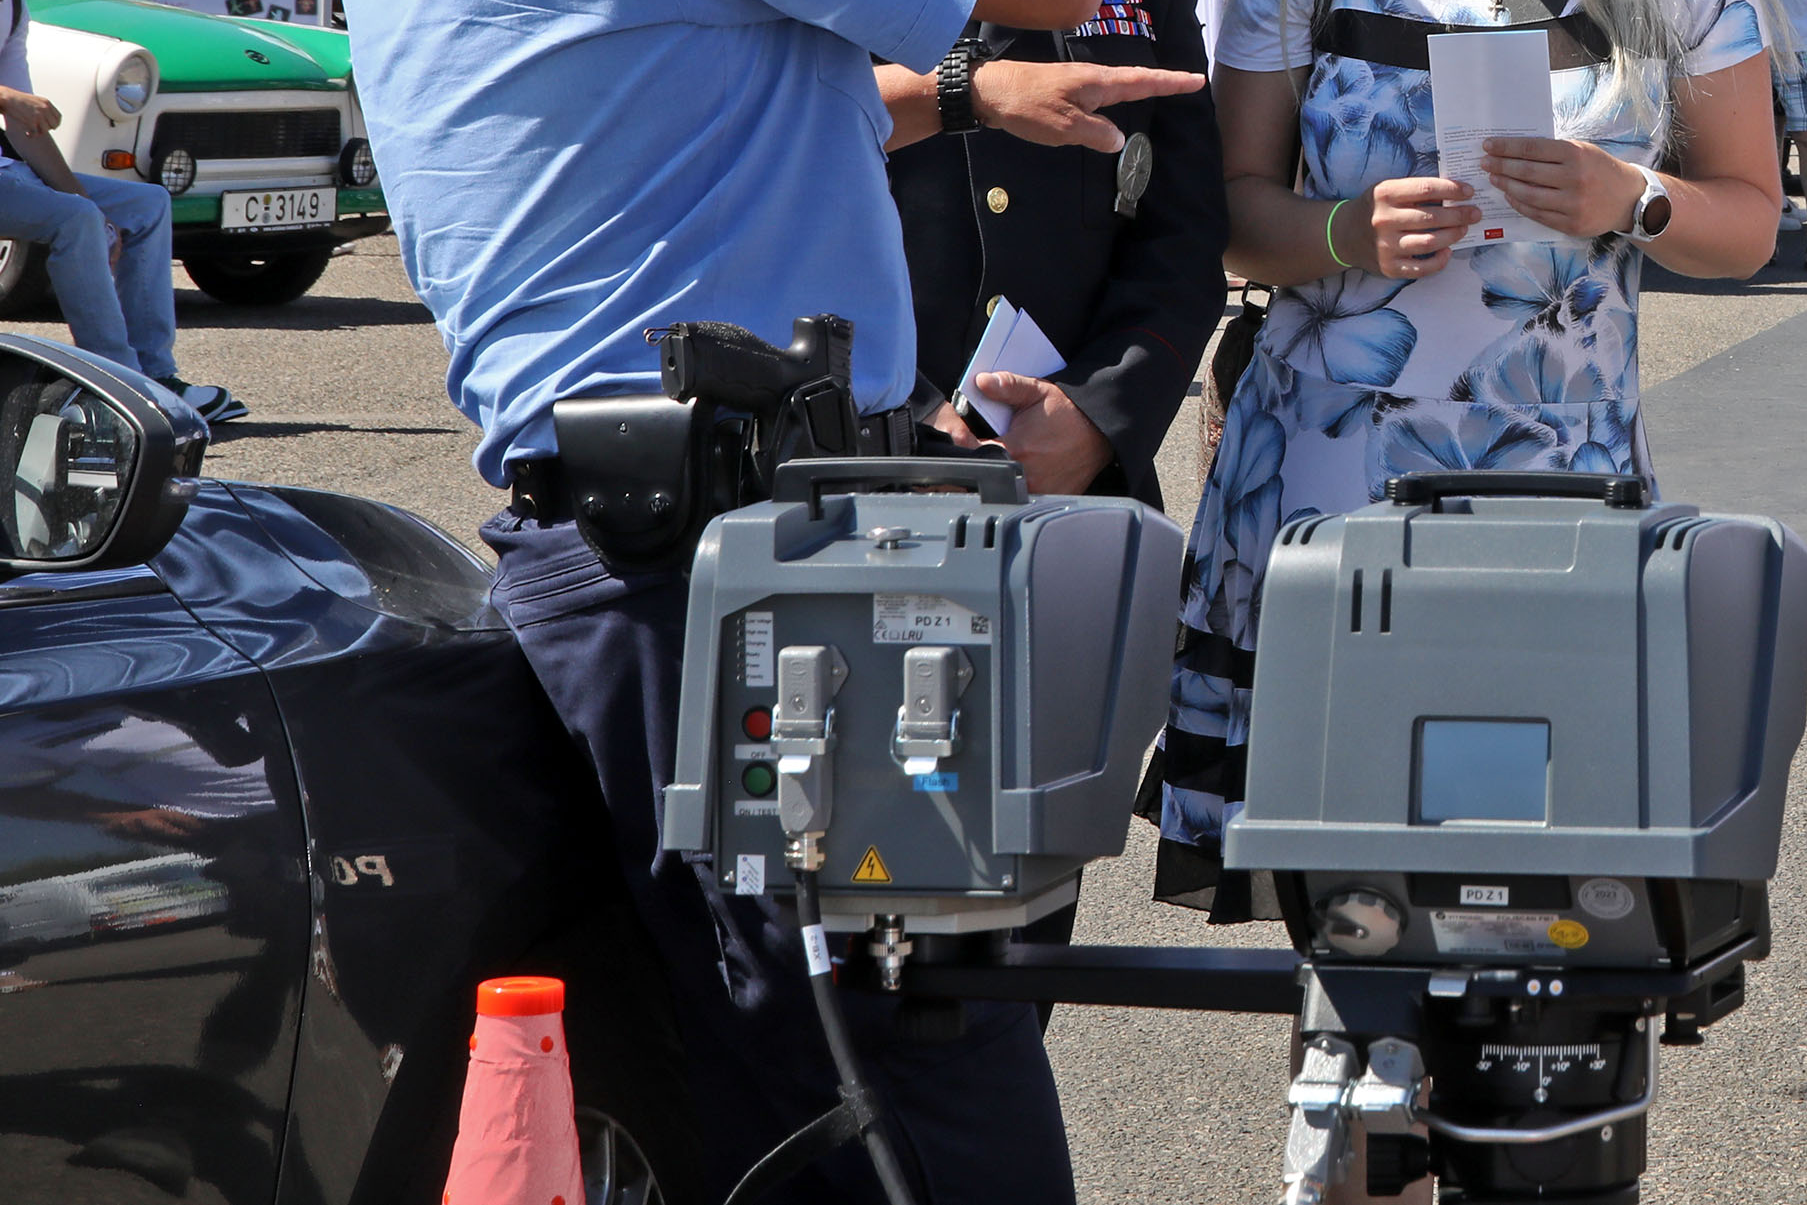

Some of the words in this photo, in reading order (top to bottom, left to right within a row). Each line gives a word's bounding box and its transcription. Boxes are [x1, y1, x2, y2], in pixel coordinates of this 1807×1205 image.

[915, 616, 932, 626] PD
[934, 616, 942, 626] Z
[945, 616, 951, 626] 1
[902, 630, 924, 641] LRU
[922, 776, 951, 786] Flash
[1466, 889, 1484, 901] PD
[1486, 889, 1495, 901] Z
[1498, 889, 1504, 901] 1
